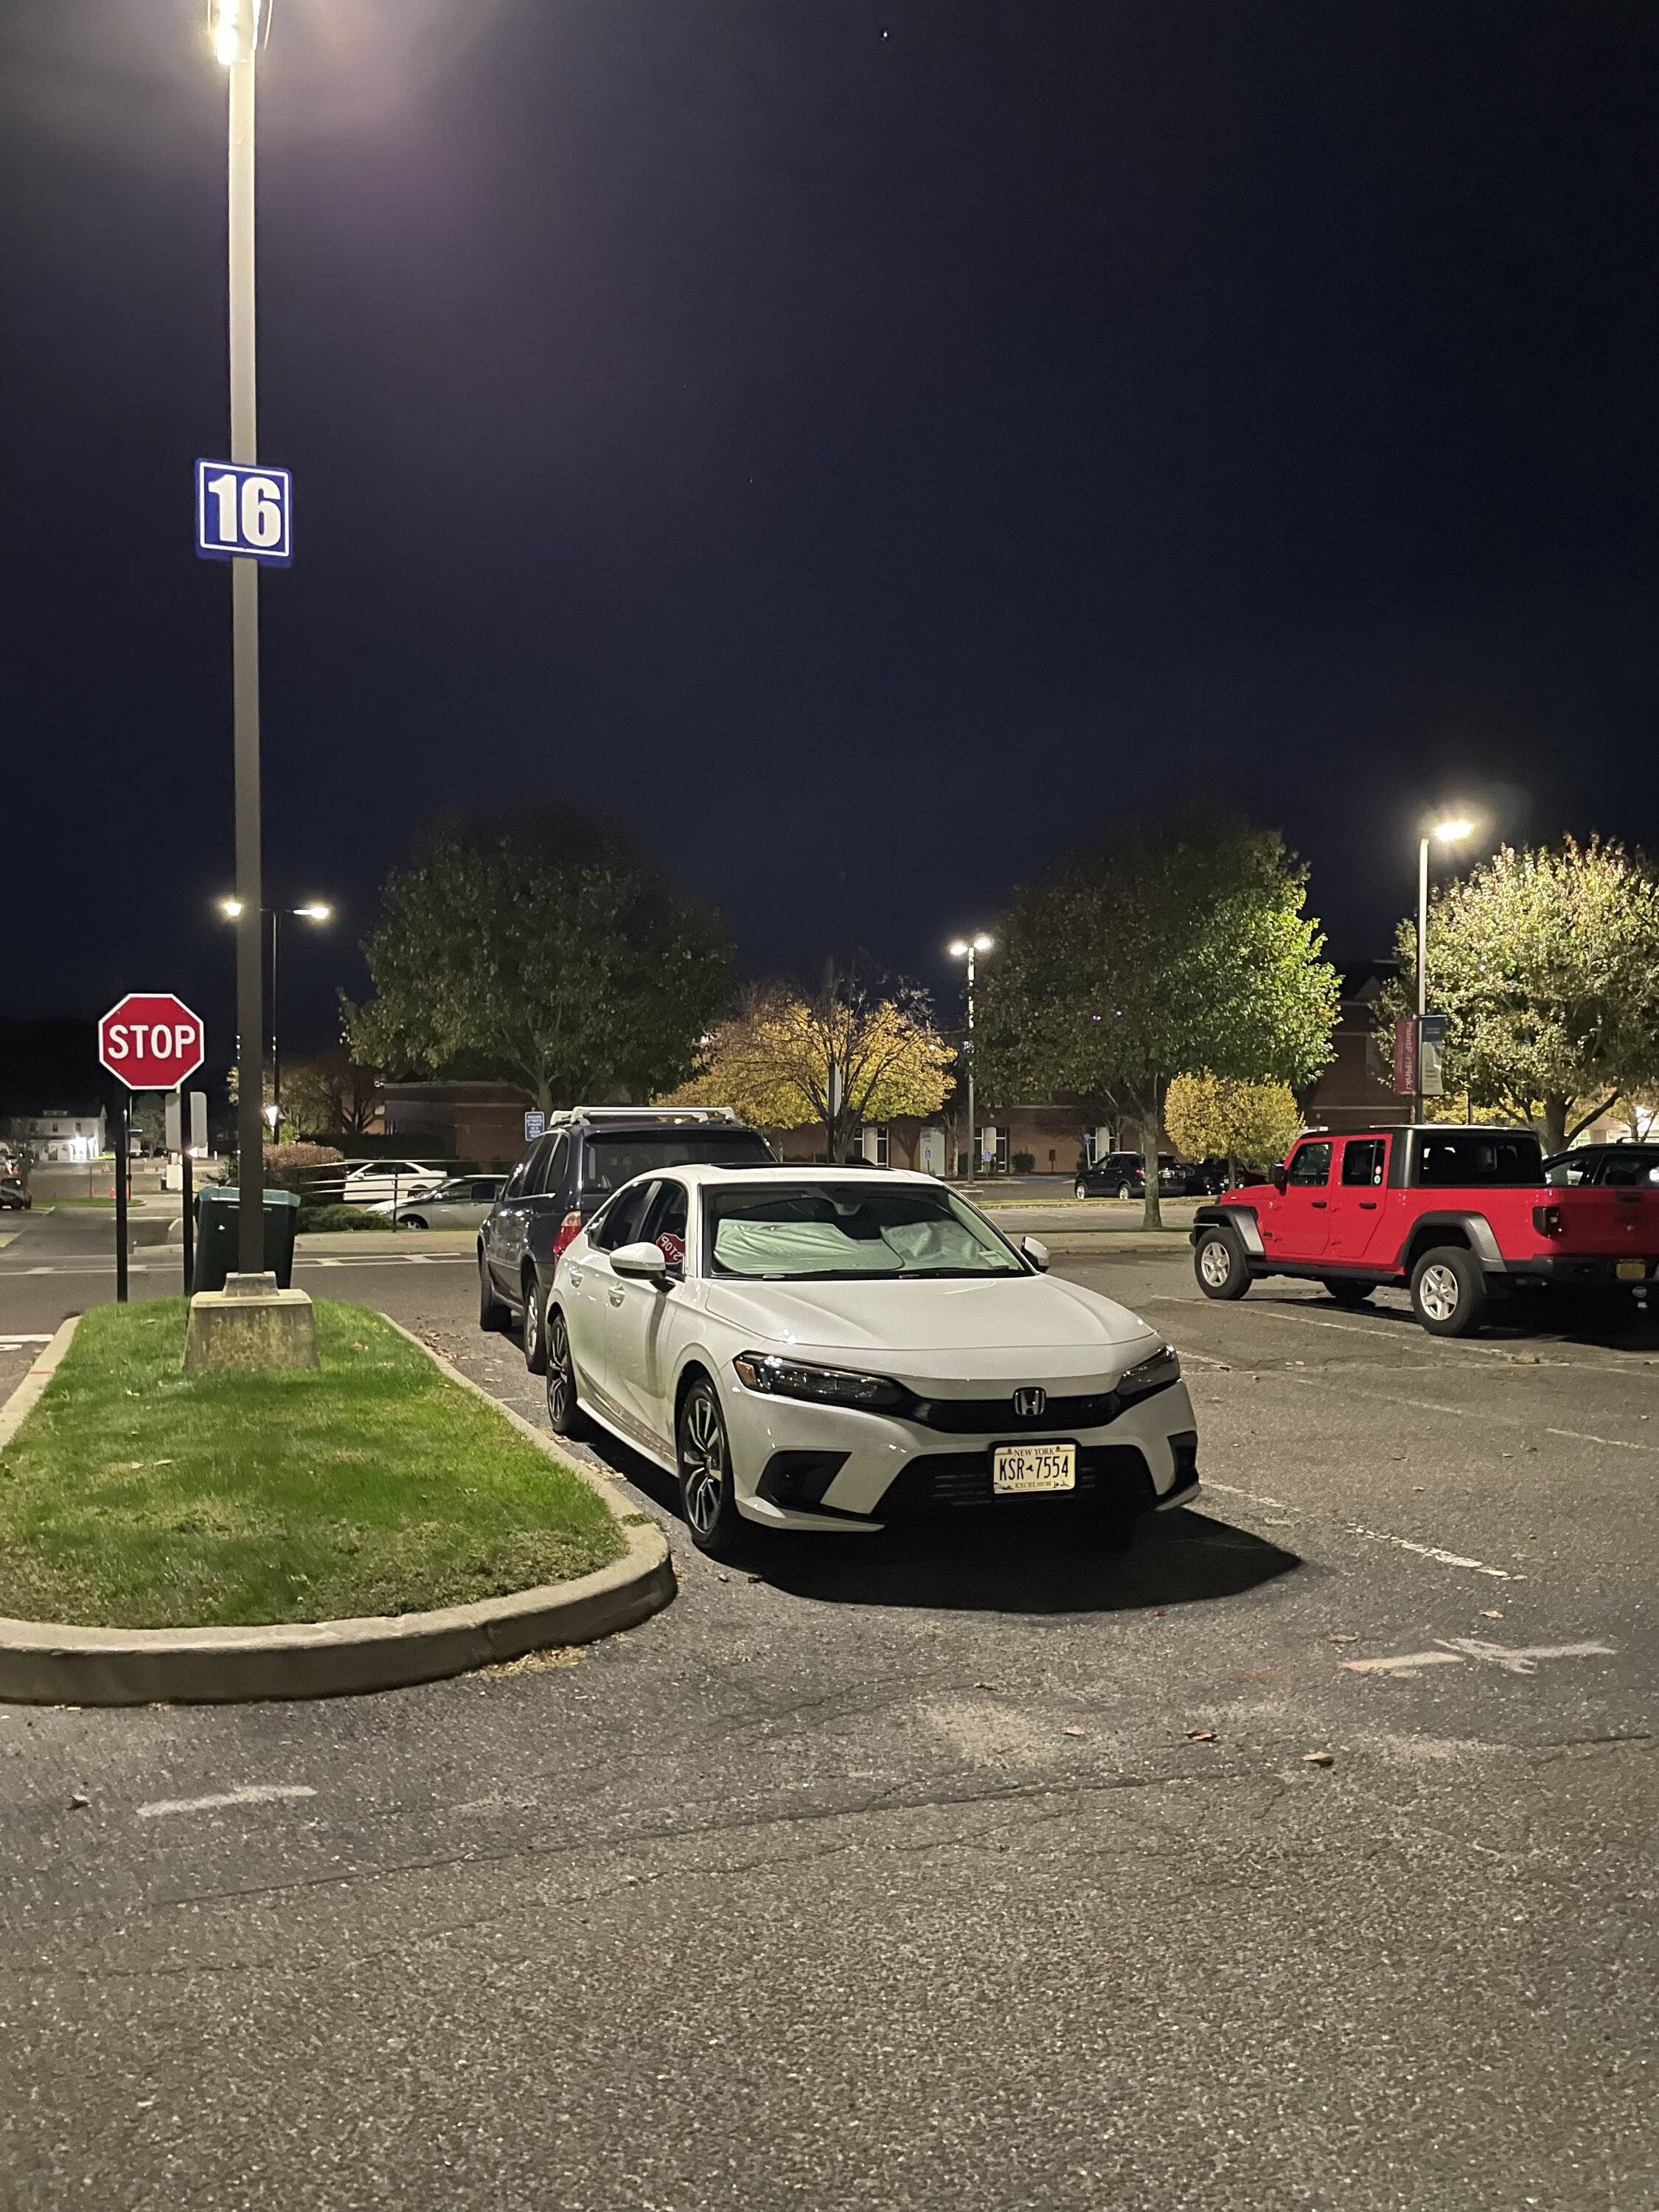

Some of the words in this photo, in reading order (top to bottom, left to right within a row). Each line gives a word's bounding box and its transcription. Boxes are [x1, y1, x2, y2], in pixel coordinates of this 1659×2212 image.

[208, 474, 281, 547] 16
[108, 1024, 196, 1059] STOP
[1034, 1447, 1054, 1455] YORK
[999, 1458, 1024, 1481] KSR
[1036, 1455, 1068, 1478] 7554
